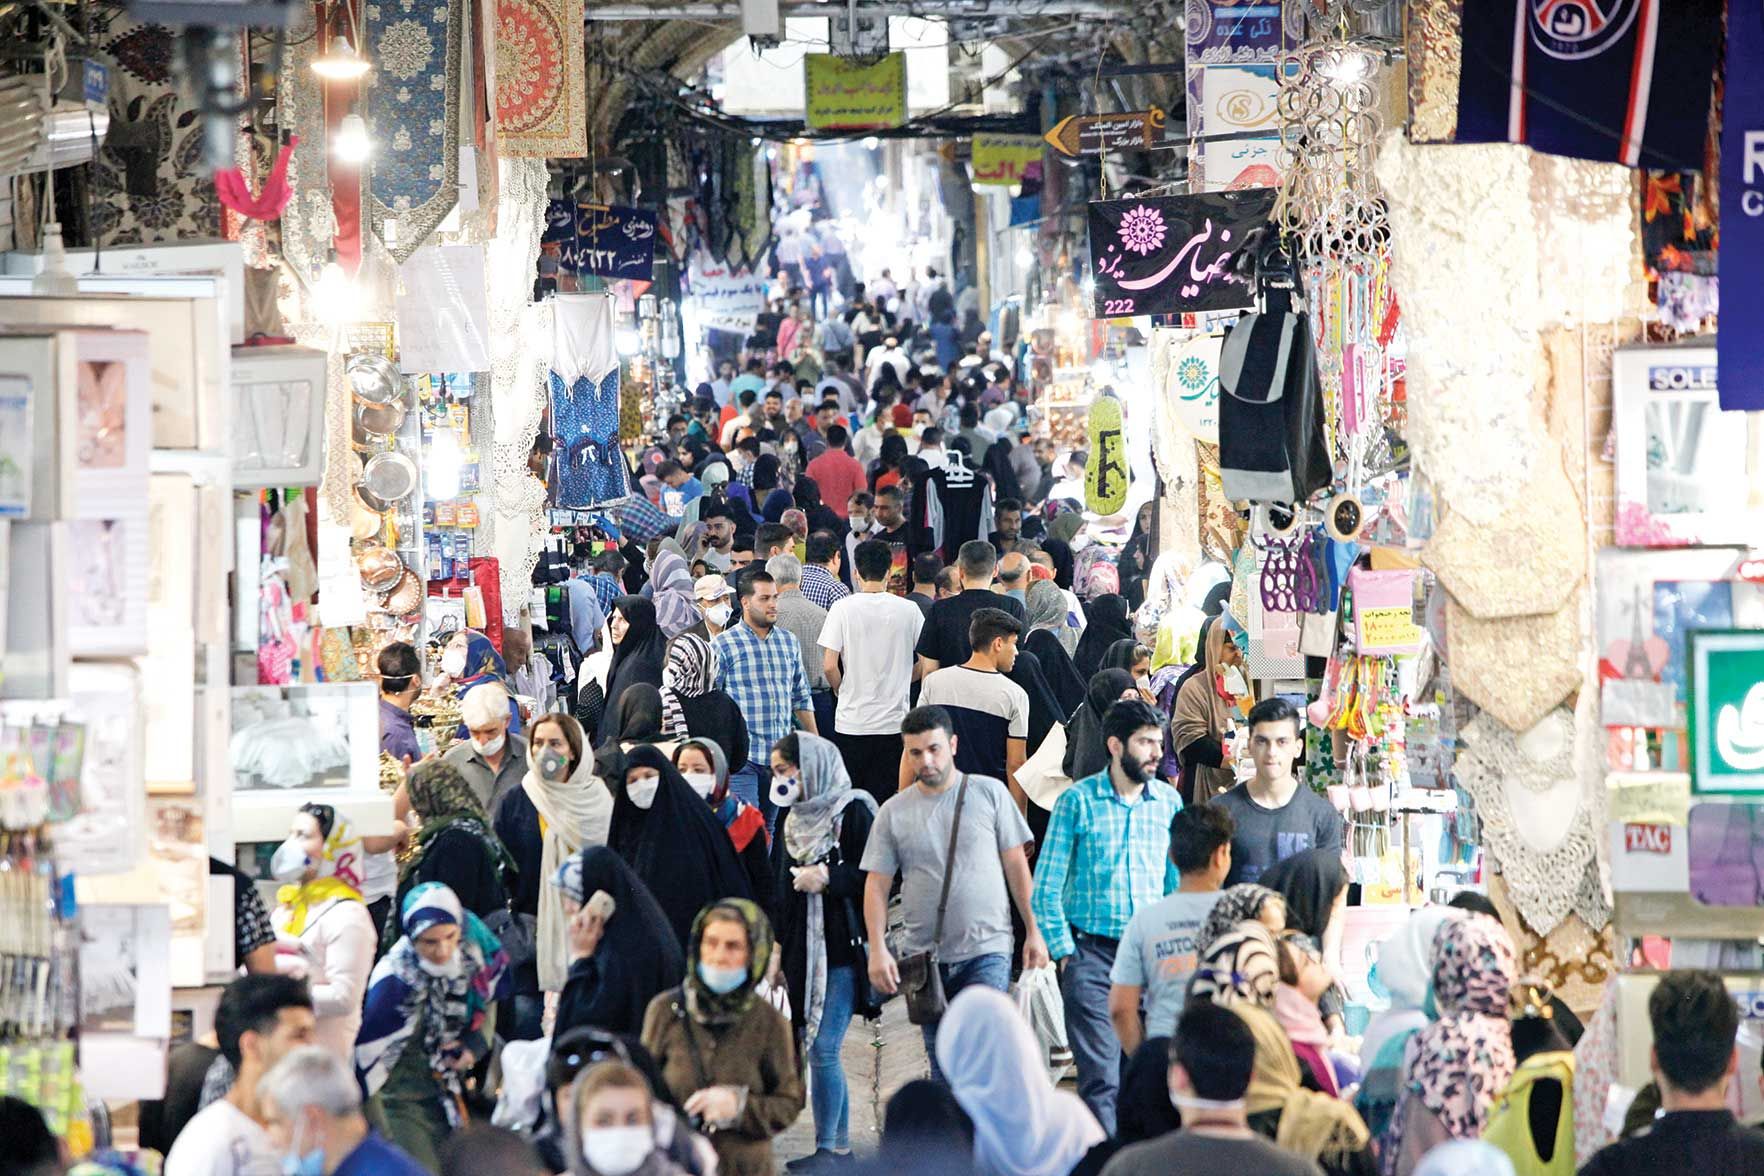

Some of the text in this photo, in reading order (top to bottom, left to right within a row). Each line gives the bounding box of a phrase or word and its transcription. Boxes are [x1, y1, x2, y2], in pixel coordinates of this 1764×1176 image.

[1098, 244, 1125, 279] یزد
[1105, 298, 1135, 315] 222
[1628, 826, 1669, 850] TAC
